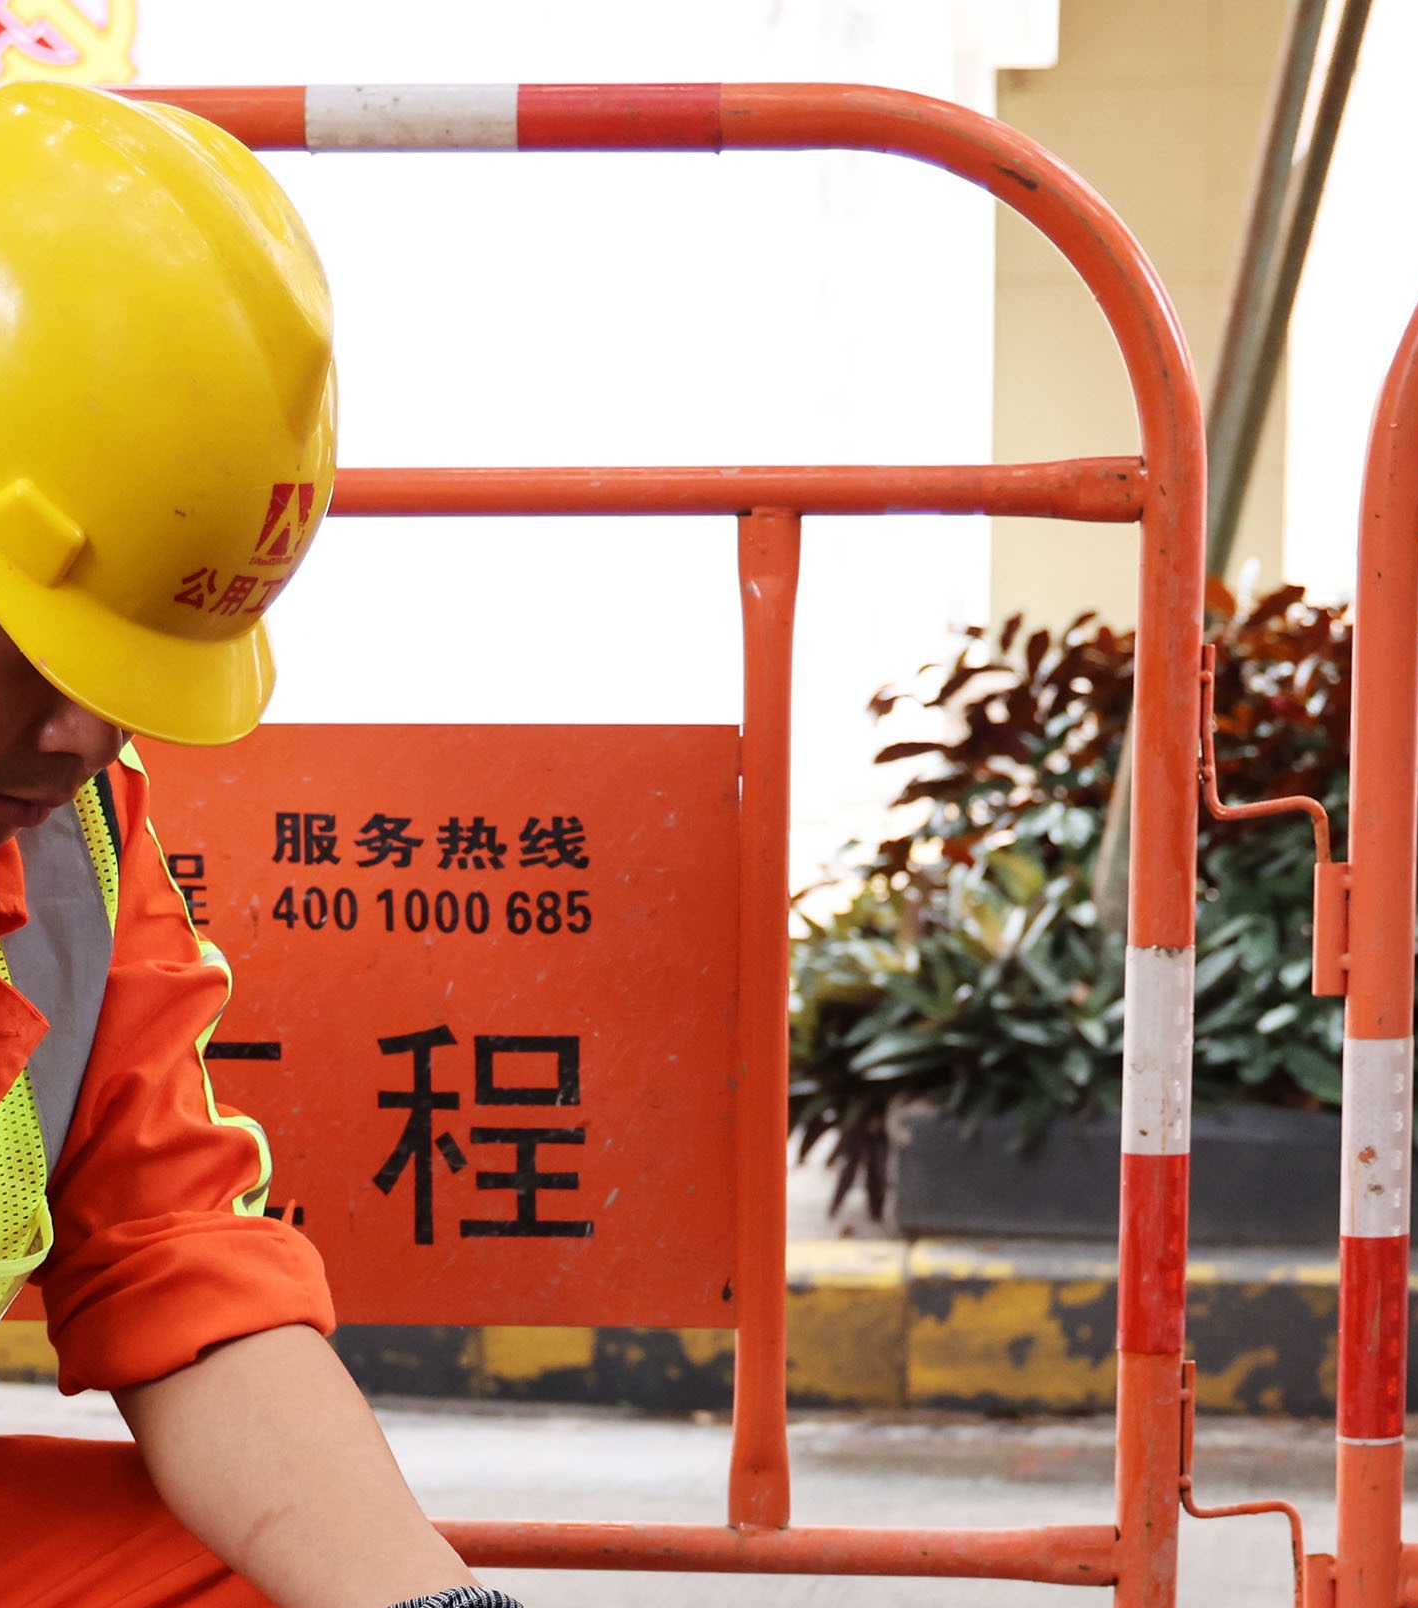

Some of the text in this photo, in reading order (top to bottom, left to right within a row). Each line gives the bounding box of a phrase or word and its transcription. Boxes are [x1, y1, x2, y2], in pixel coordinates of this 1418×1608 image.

[272, 811, 590, 870] 服务热线
[272, 886, 592, 935] 400 1000 685
